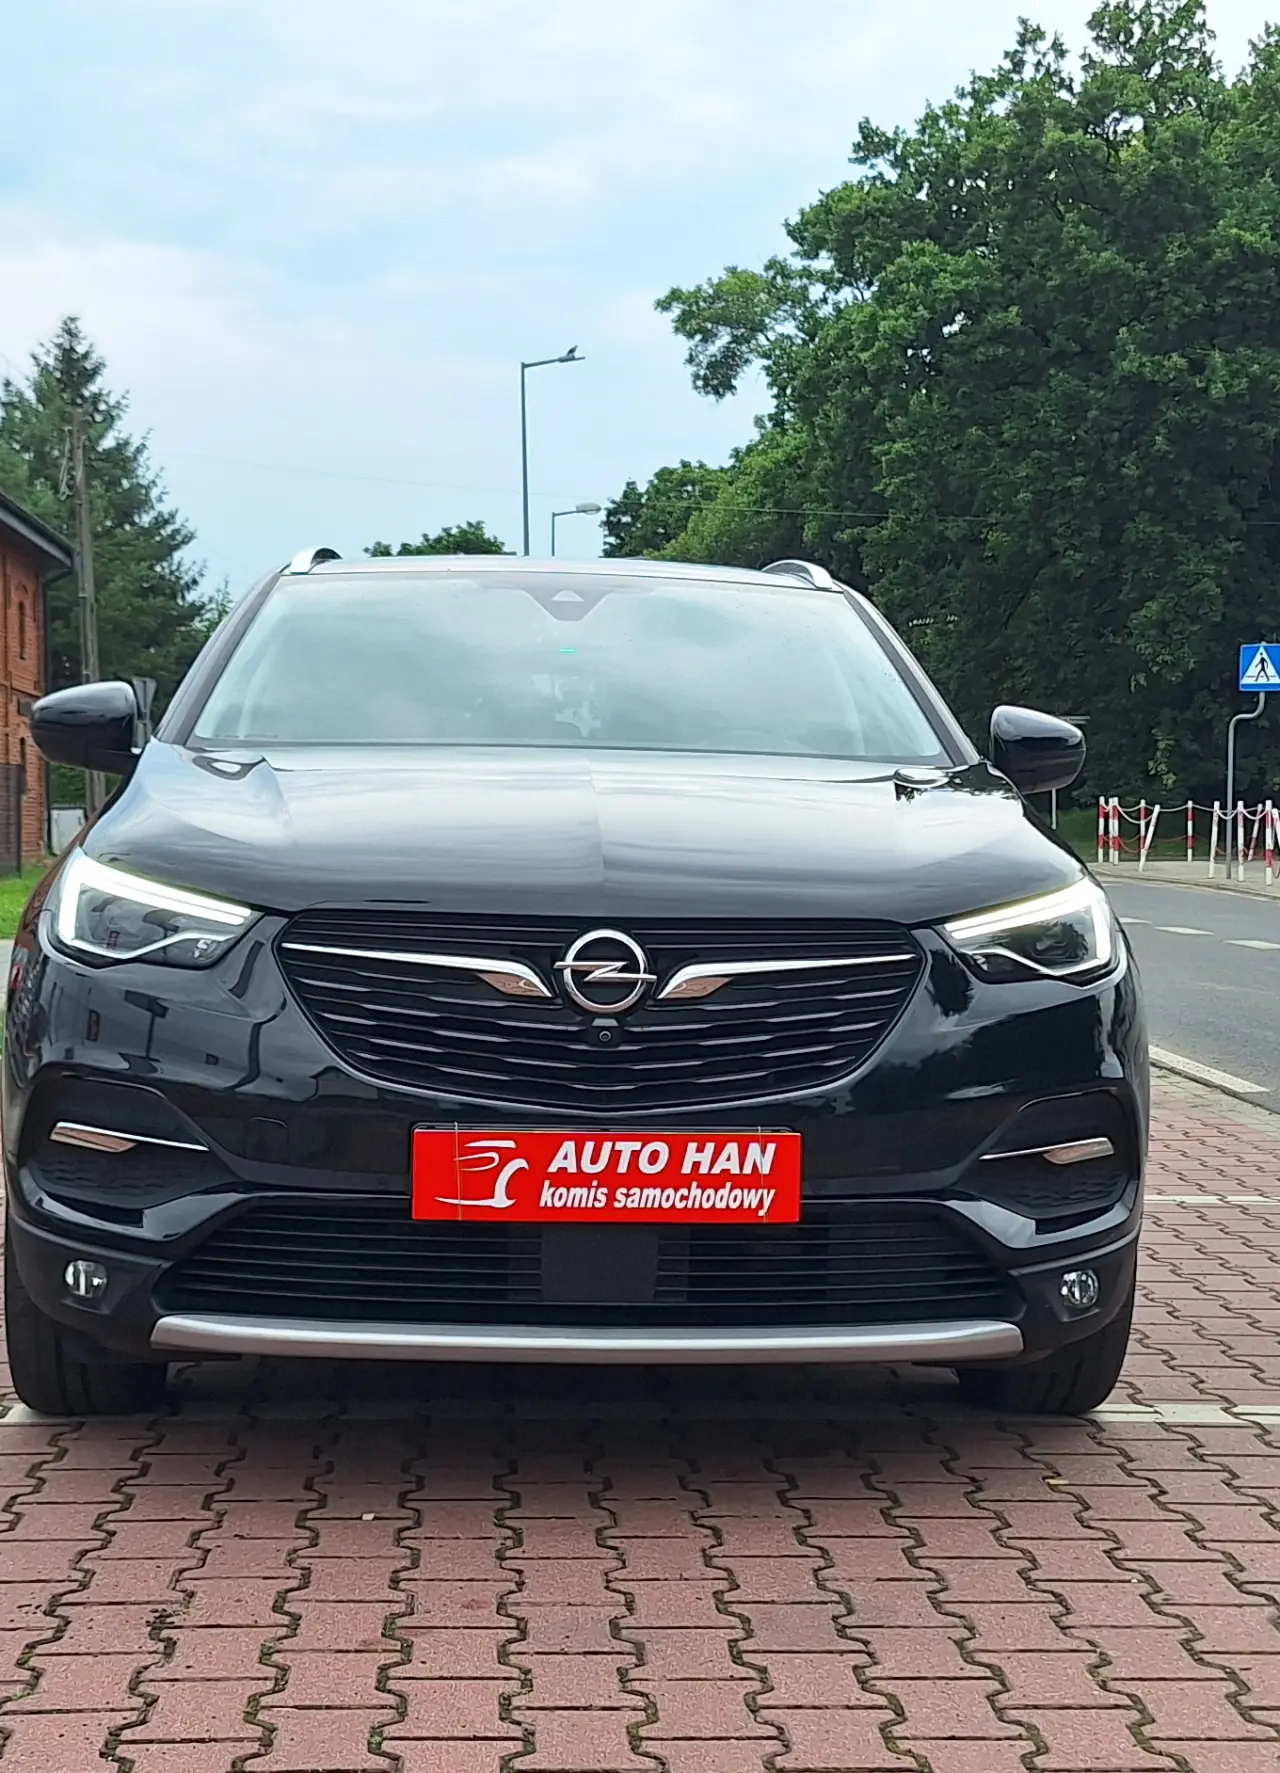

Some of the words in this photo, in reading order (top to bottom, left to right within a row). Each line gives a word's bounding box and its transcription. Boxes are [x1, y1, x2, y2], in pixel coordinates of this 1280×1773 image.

[547, 1140, 669, 1175] AUTO
[681, 1141, 777, 1176] HAN
[539, 1180, 607, 1209] komis
[613, 1181, 777, 1217] samochodowy
